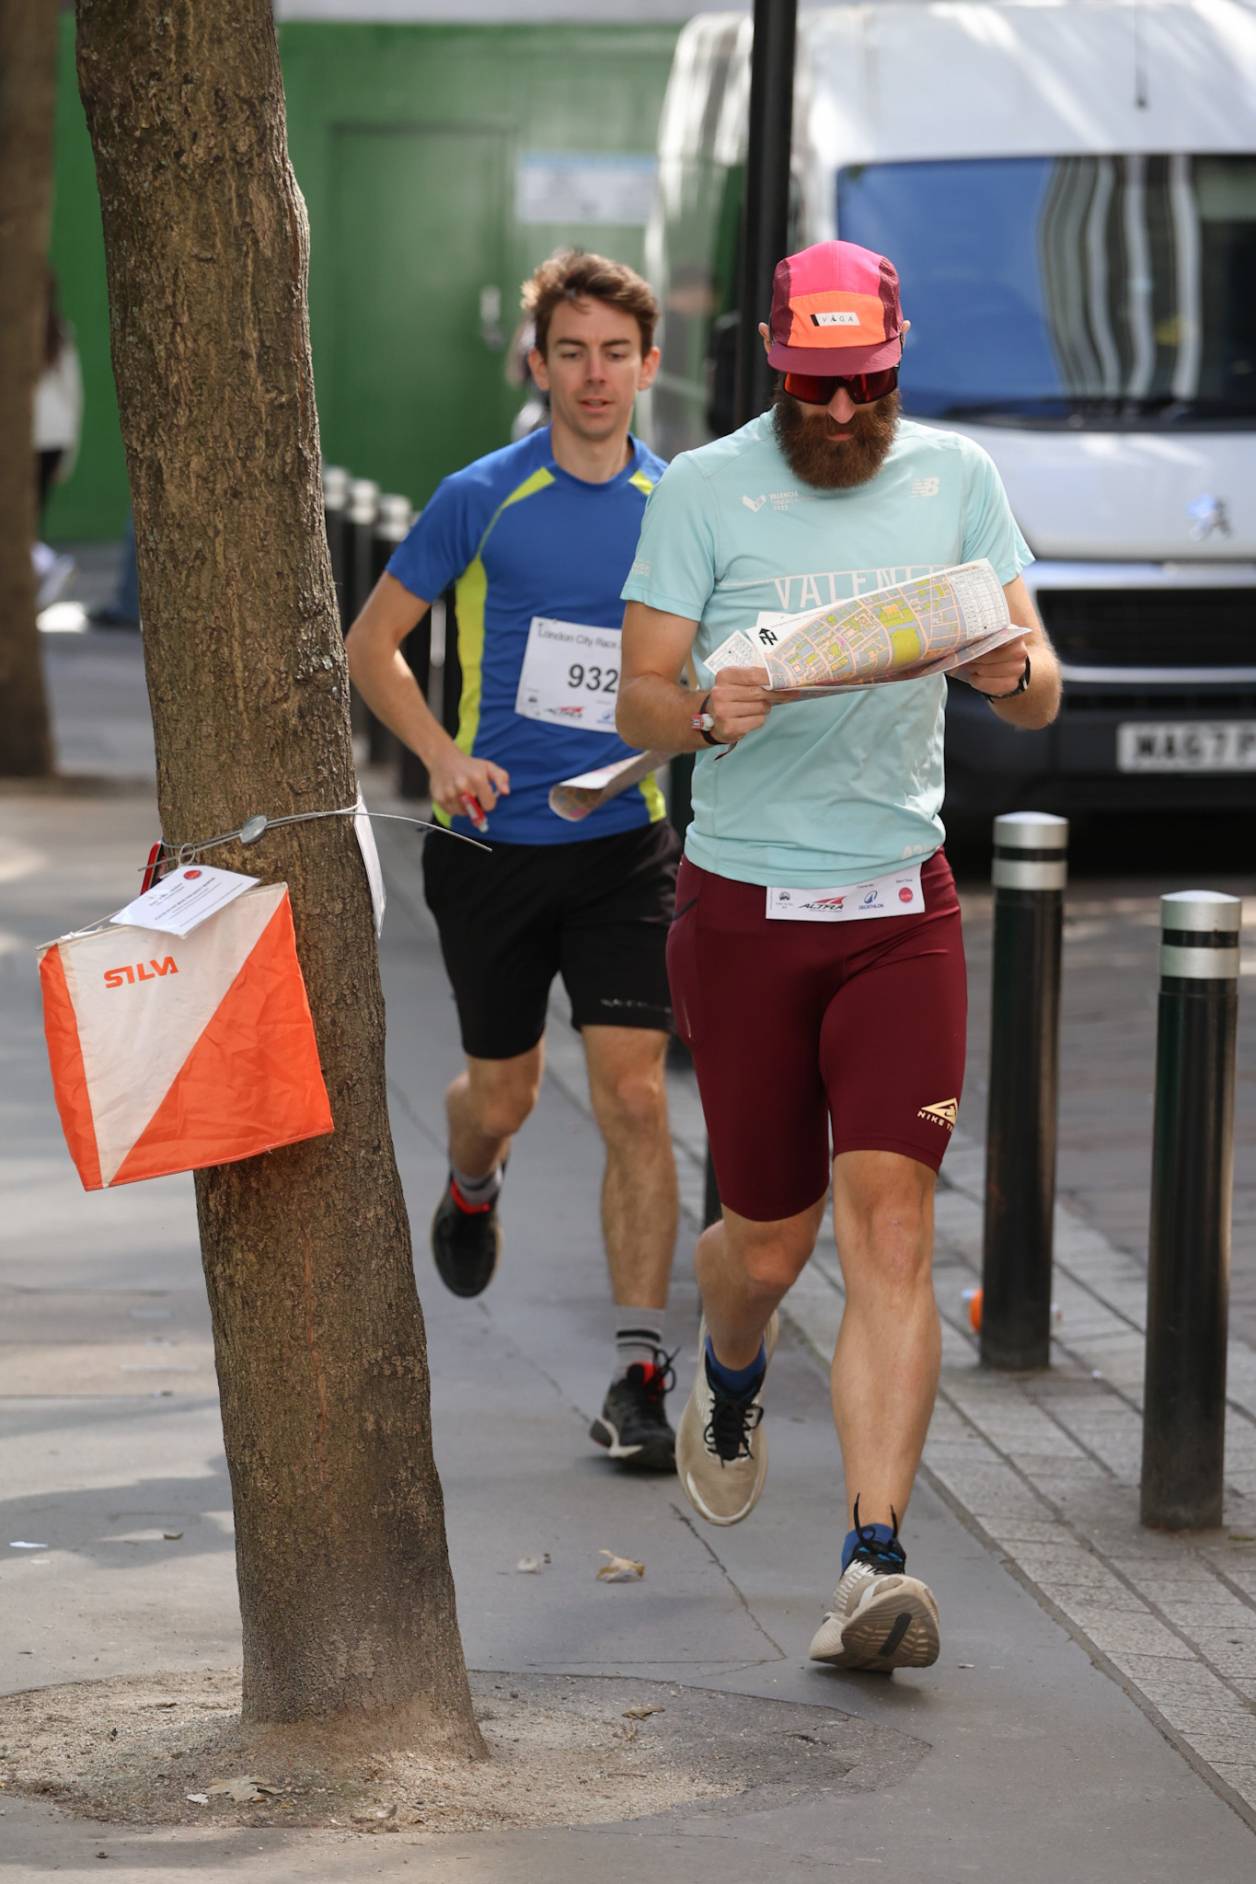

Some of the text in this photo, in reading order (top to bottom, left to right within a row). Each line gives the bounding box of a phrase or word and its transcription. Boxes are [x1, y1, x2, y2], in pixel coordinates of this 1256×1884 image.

[567, 663, 619, 693] 932
[104, 956, 179, 989] SILVA
[917, 1111, 945, 1127] NIKE
